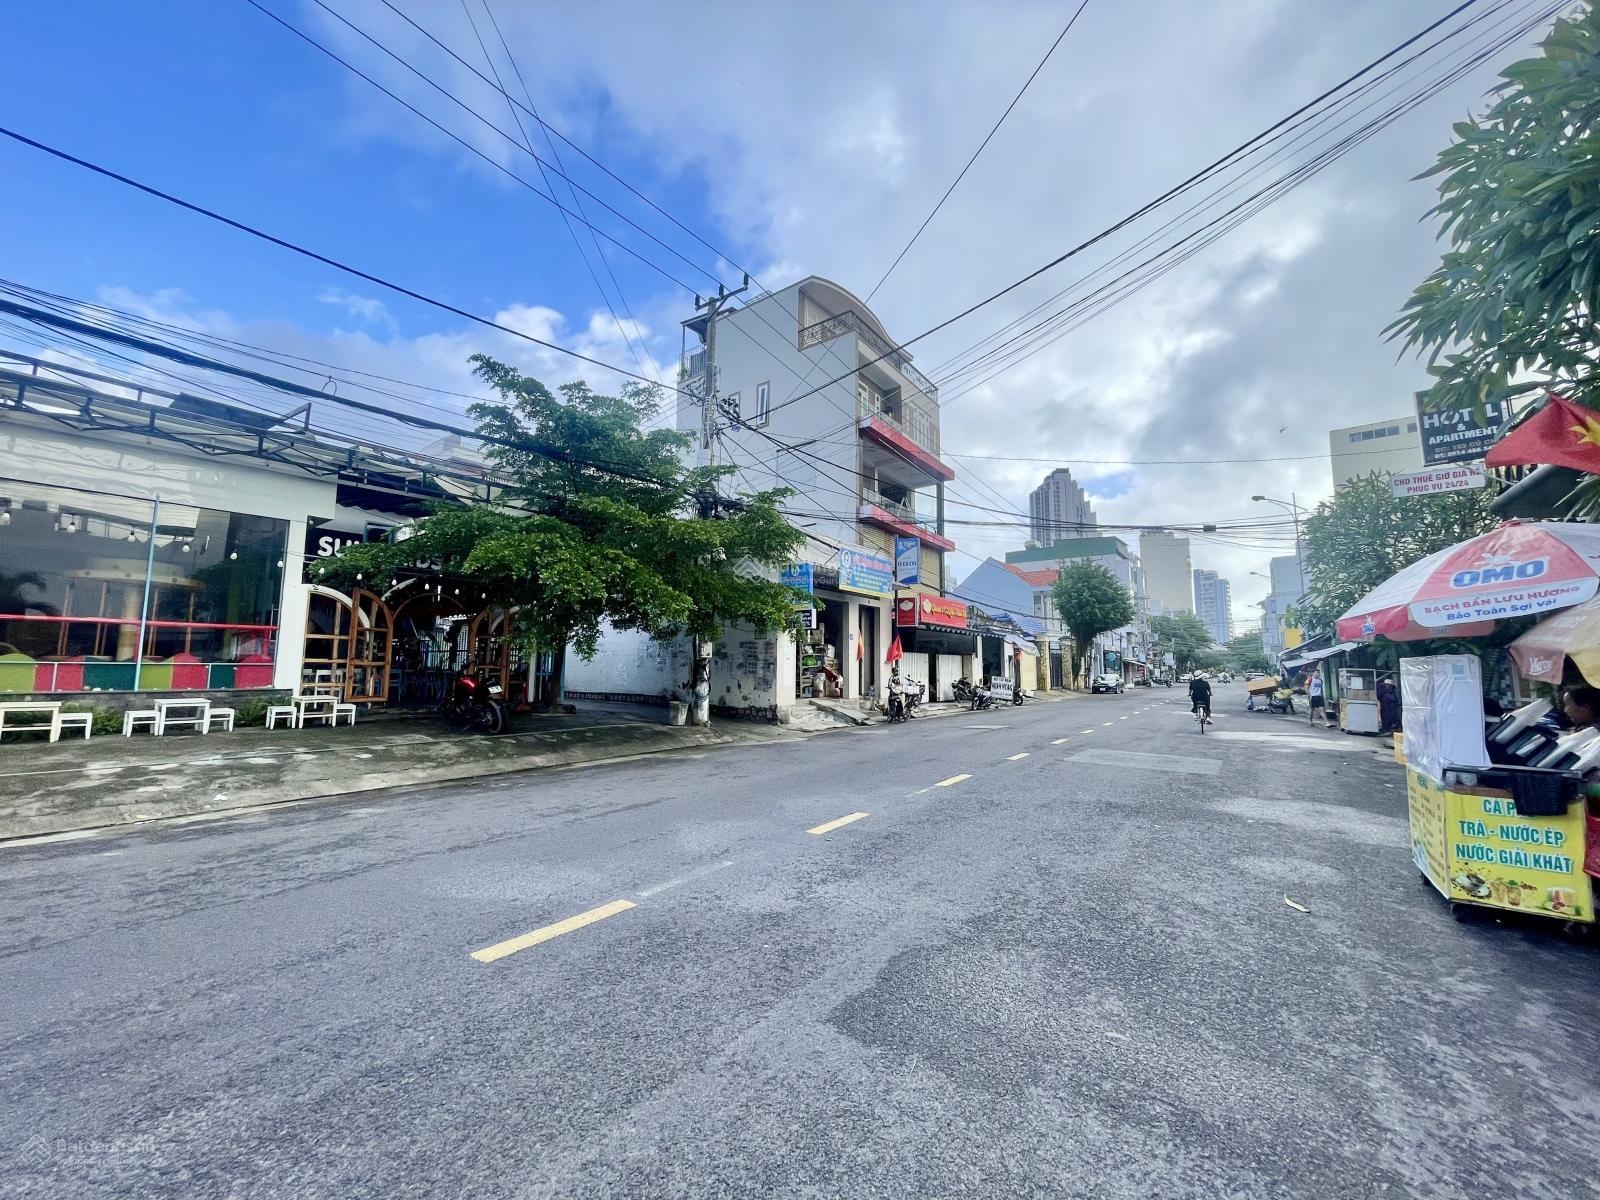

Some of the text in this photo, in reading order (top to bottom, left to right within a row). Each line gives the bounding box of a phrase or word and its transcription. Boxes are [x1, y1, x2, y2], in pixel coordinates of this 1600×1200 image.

[1457, 423, 1466, 431] &
[1453, 559, 1545, 588] OMO
[1494, 594, 1523, 604] LƯU
[1527, 586, 1581, 599] HƯƠNG
[1459, 819, 1485, 837] TRÀ
[1500, 824, 1540, 843] NƯỚC
[1545, 827, 1564, 846] ÉP
[1455, 843, 1571, 873] NƯỚC GIẢI KHÁT
